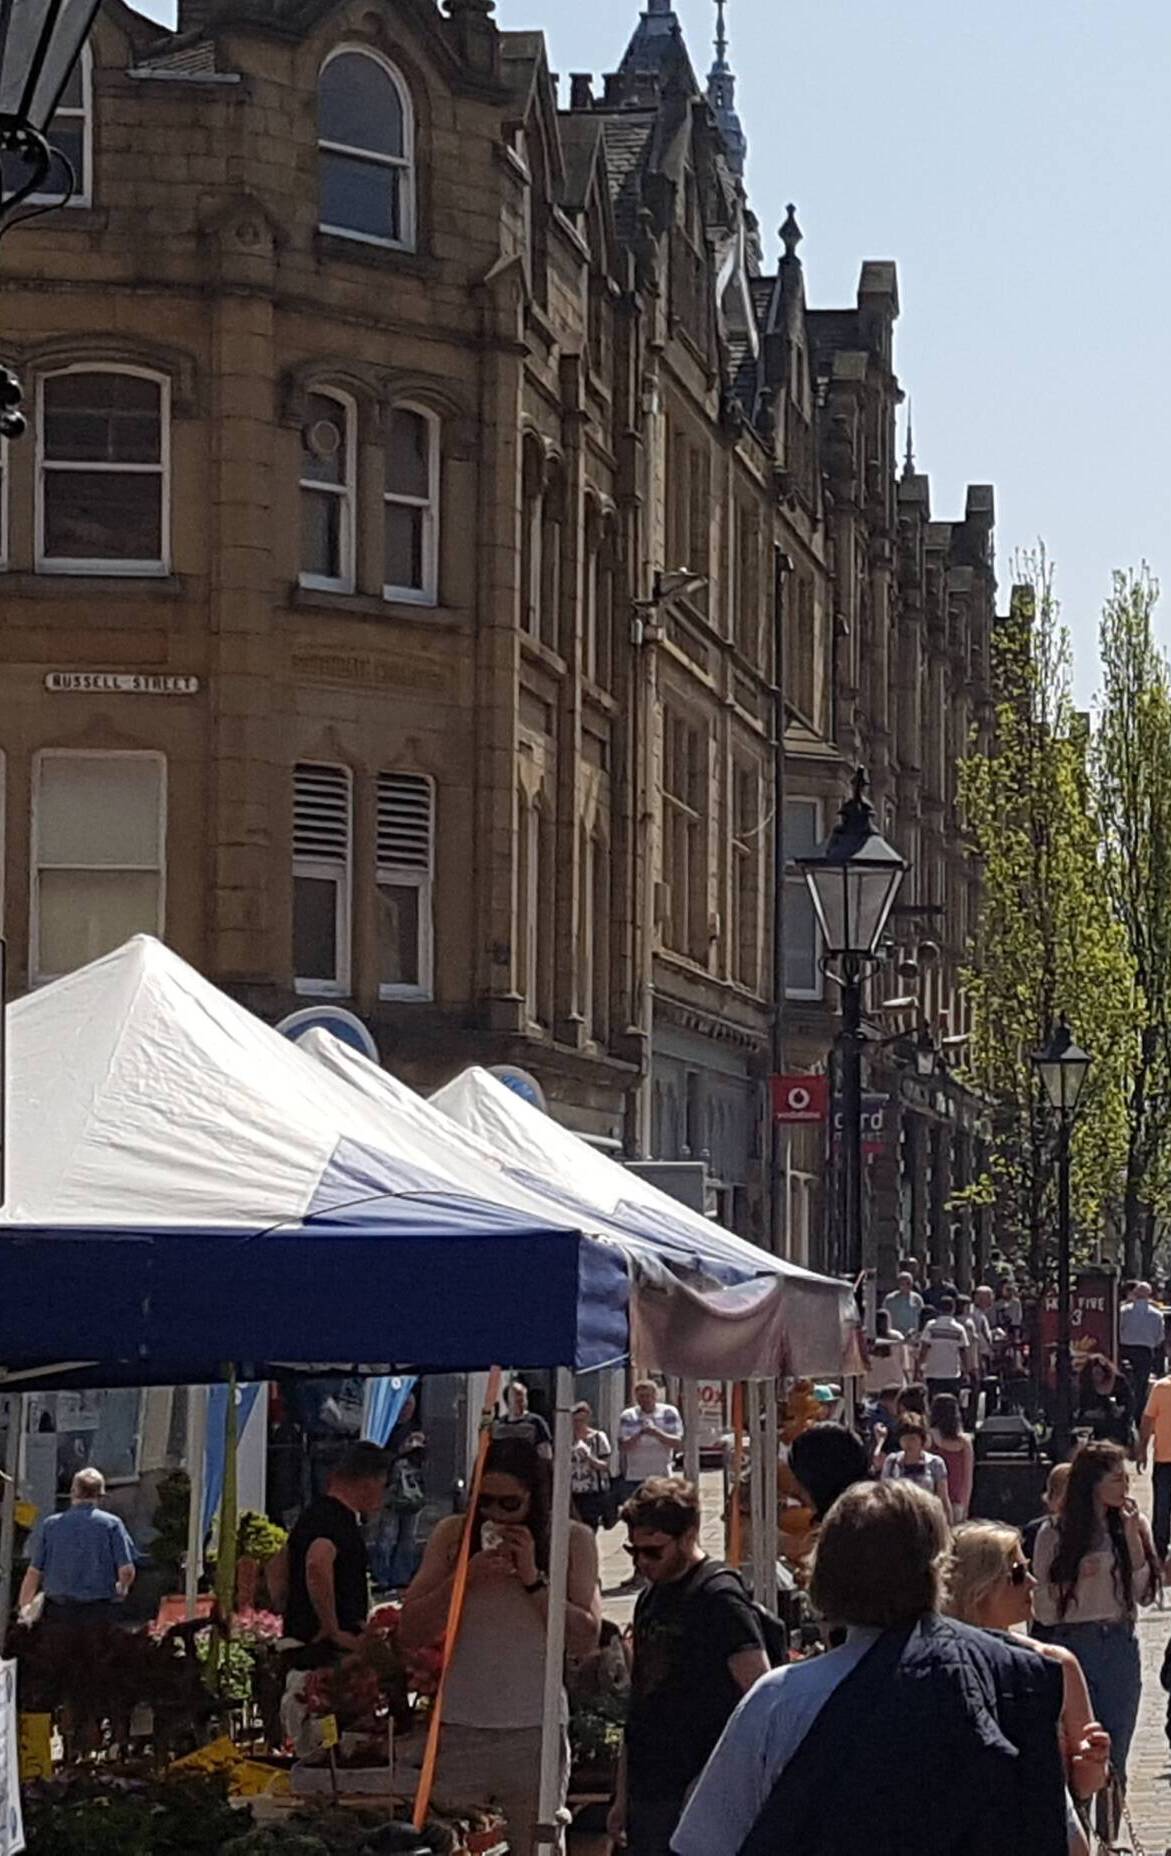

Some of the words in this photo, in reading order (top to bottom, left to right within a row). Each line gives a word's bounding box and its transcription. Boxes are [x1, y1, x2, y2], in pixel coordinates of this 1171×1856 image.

[52, 674, 121, 689] RUSSELL
[132, 676, 191, 691] STREET
[834, 1108, 884, 1131] crd
